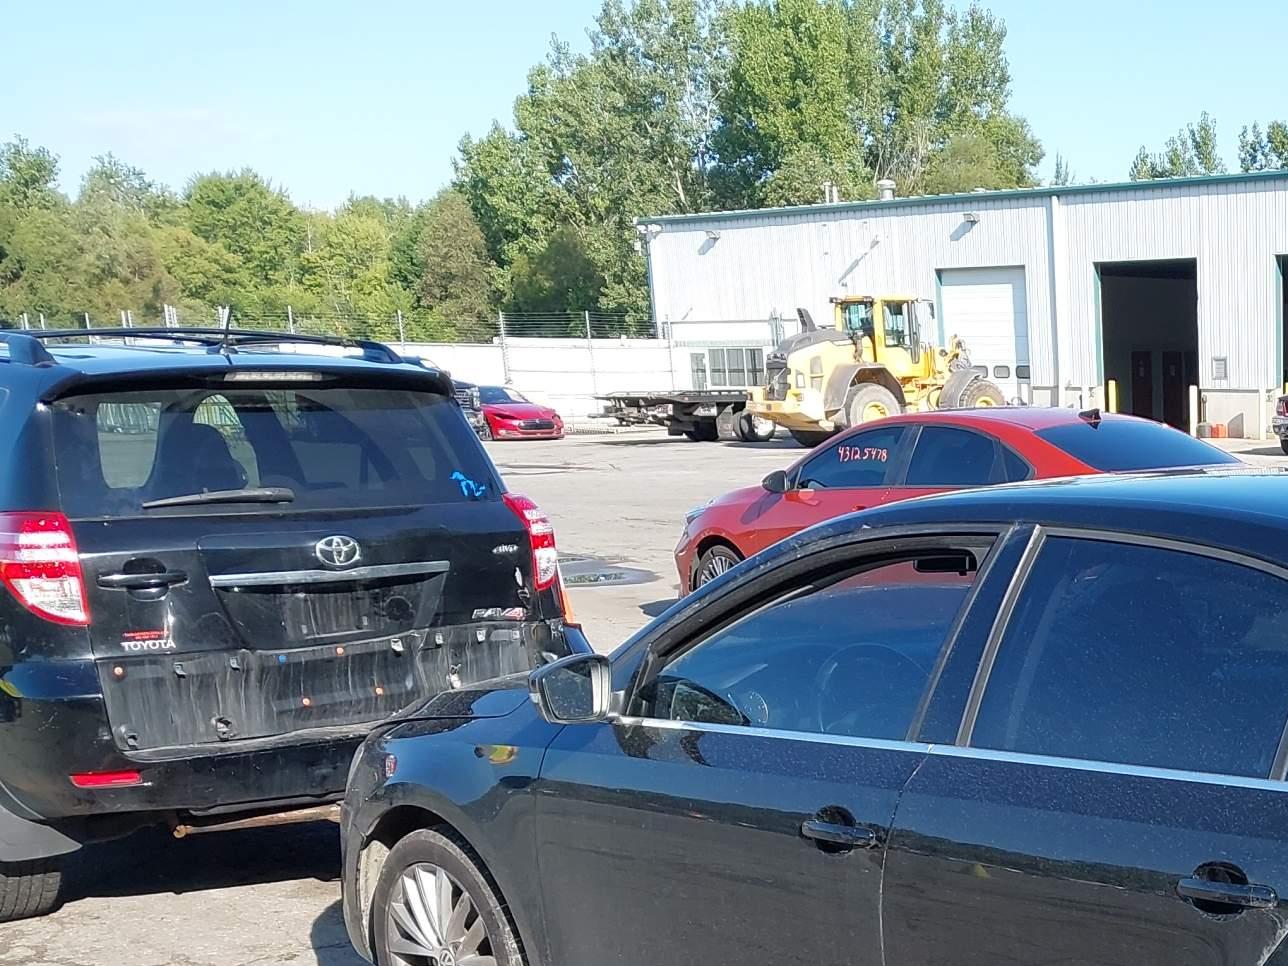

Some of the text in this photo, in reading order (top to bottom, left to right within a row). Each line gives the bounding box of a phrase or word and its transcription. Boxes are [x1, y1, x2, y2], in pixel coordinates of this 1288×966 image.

[838, 446, 888, 463] 4312 5478
[120, 639, 177, 651] TOYOTA
